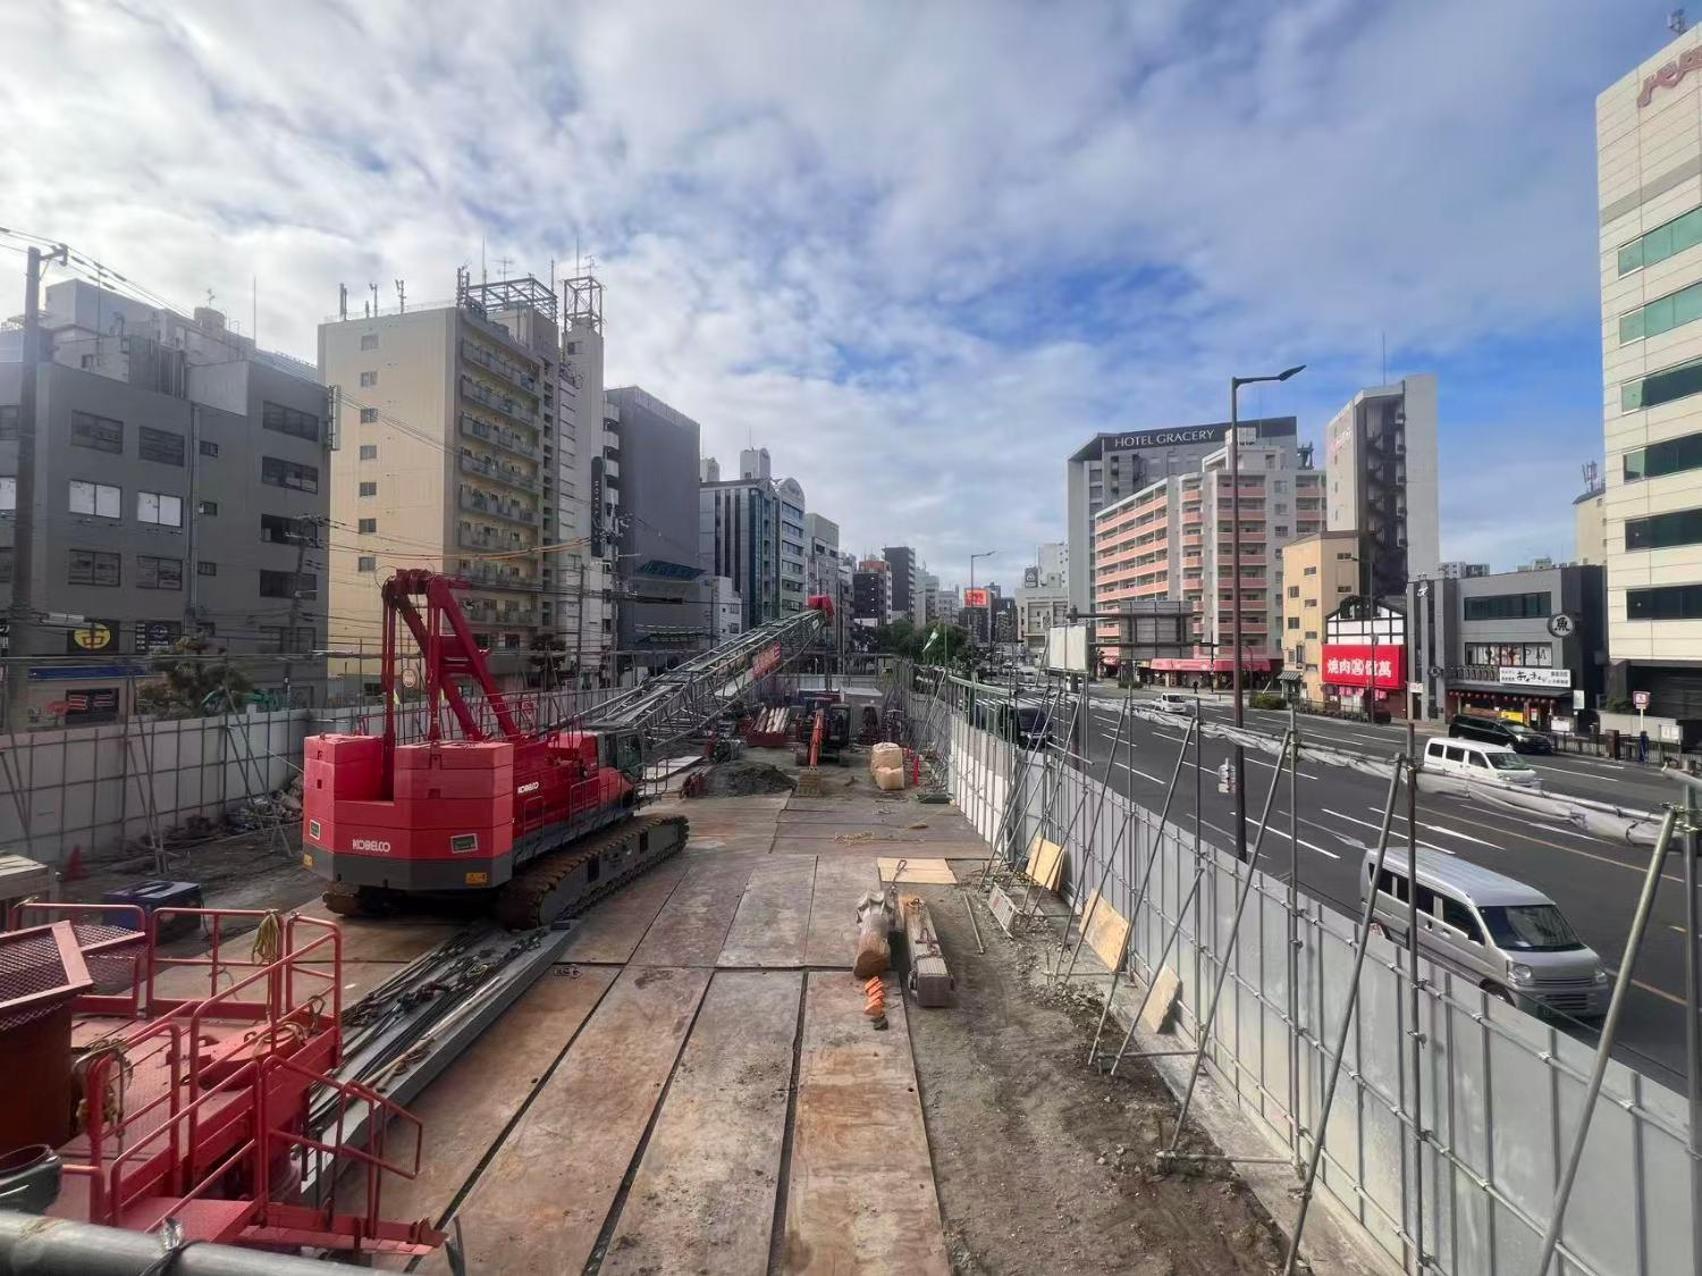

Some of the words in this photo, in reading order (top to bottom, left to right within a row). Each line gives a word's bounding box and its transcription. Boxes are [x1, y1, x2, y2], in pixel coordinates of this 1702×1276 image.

[1114, 435, 1153, 448] HOTEL
[1157, 429, 1215, 444] GRACERY
[1554, 616, 1570, 632] 魚
[352, 838, 391, 852] KOBELCO
